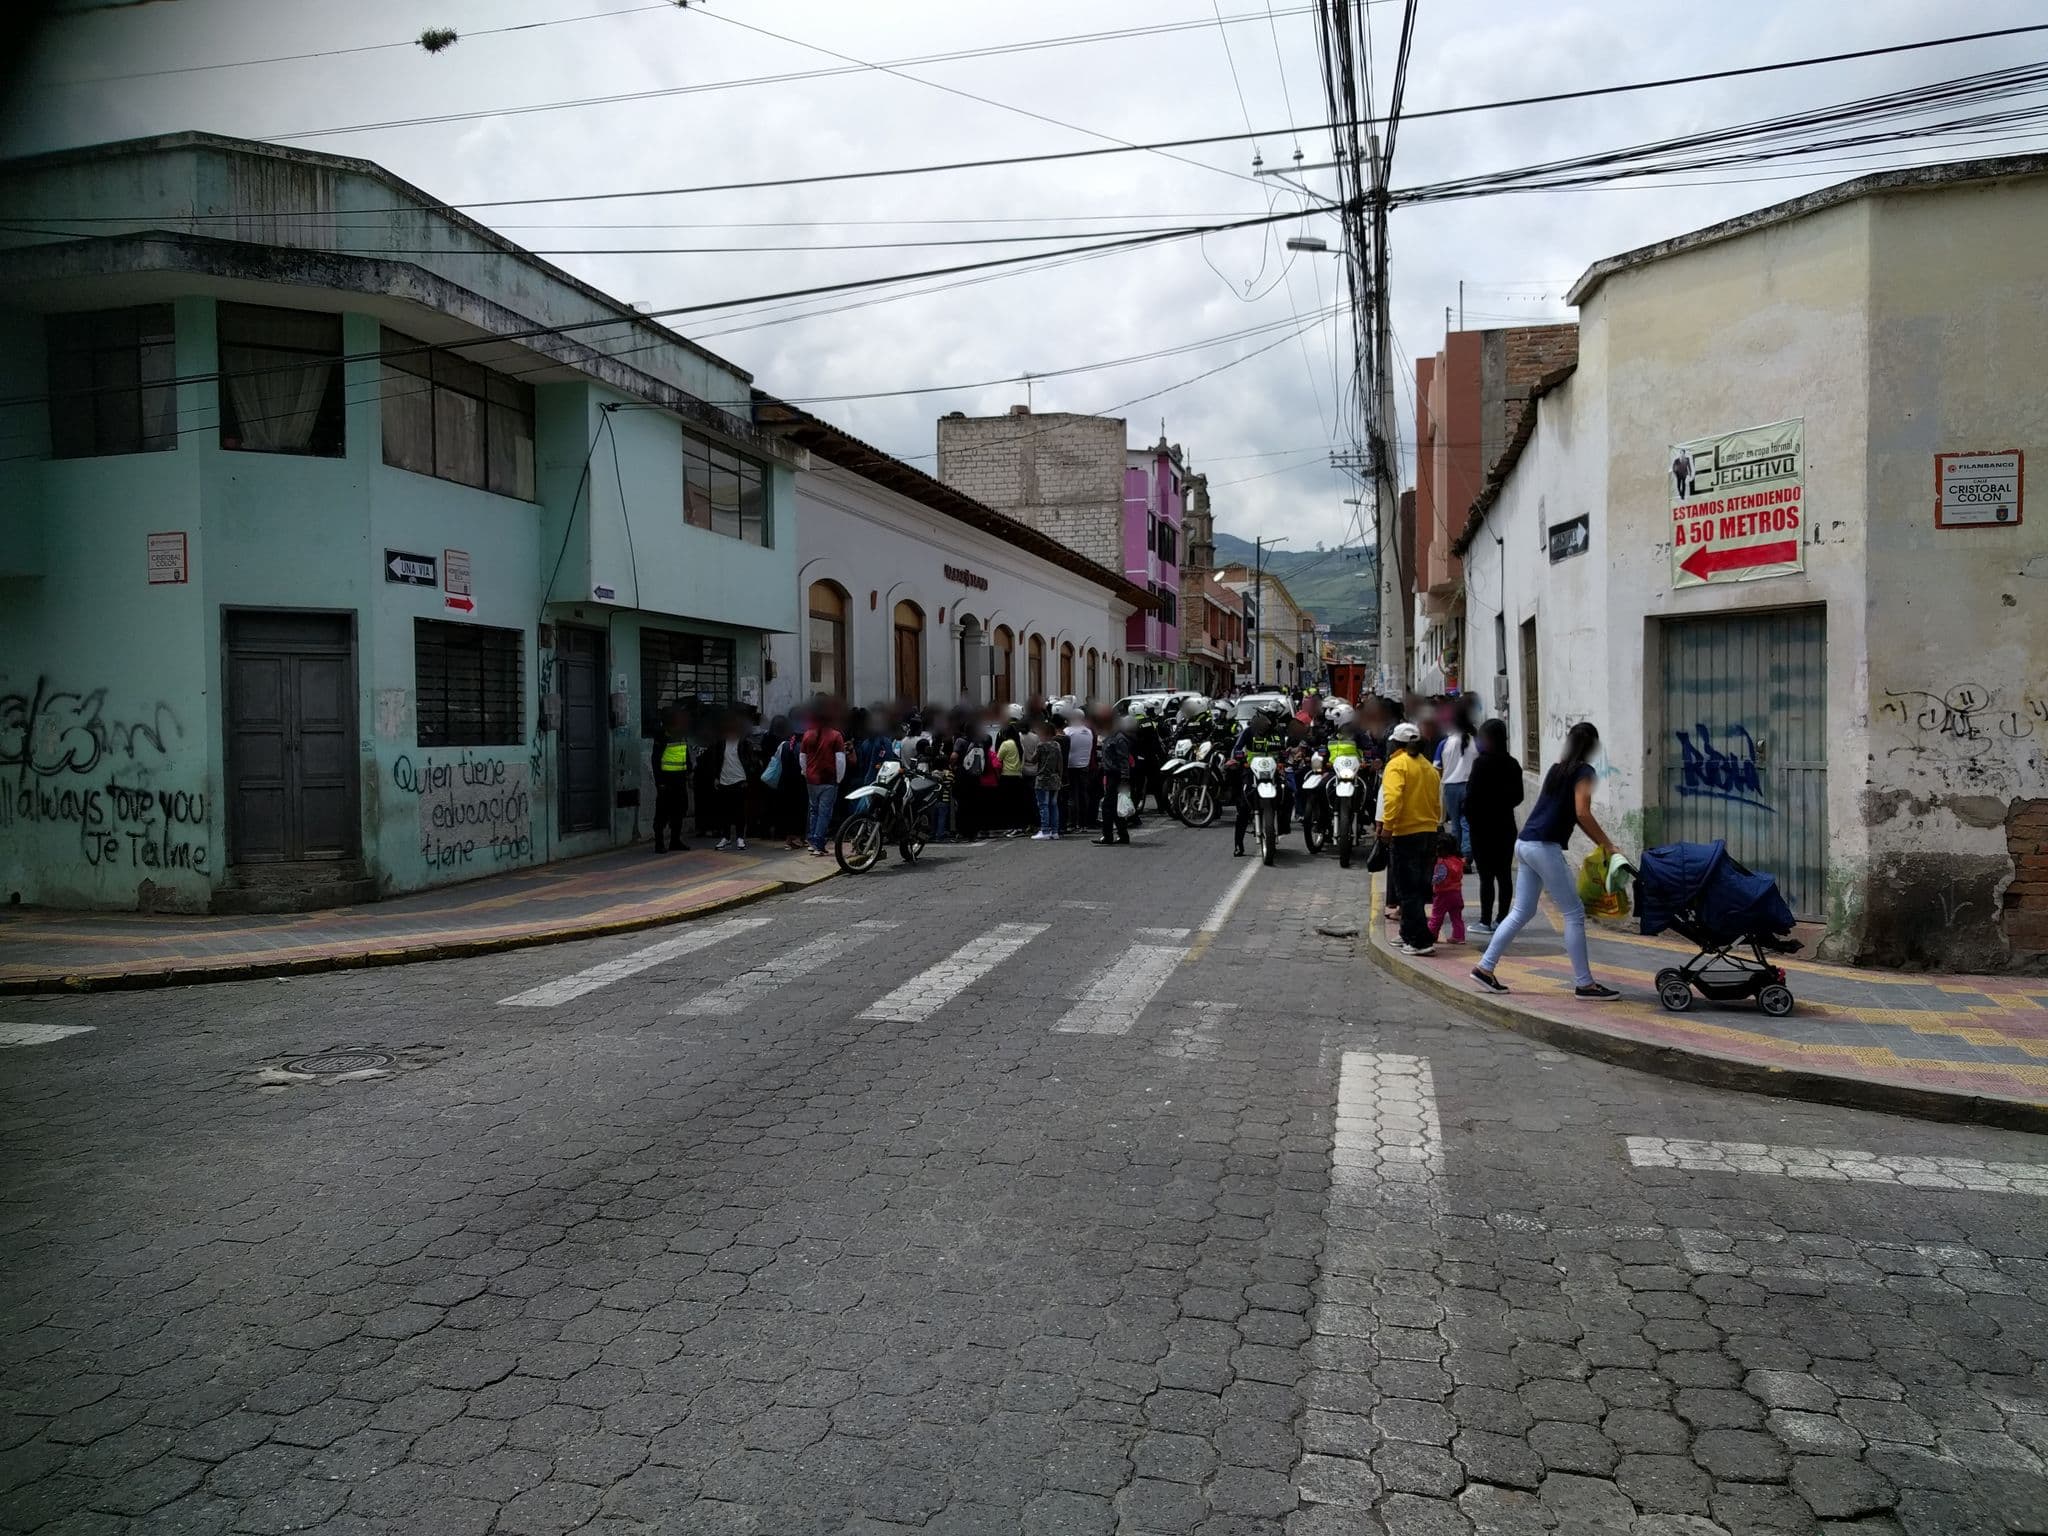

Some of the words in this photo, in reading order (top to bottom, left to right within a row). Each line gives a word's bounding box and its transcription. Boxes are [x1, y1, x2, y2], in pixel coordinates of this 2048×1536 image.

[1958, 462, 2014, 470] FILANBANCO
[1673, 500, 1724, 520] ESTAMOS
[1727, 486, 1801, 512] ATENDIENDO
[1949, 483, 2012, 494] CRISTOBAL
[1958, 493, 2002, 502] COLON
[1675, 524, 1686, 547] A
[1690, 519, 1714, 544] 50
[1720, 505, 1799, 540] METROS
[401, 561, 416, 575] UNA
[418, 564, 430, 576] VIA
[393, 755, 452, 794] Quien
[458, 750, 505, 786] tiene
[17, 776, 104, 833] always
[432, 780, 528, 828] educación
[422, 834, 474, 870] tiene
